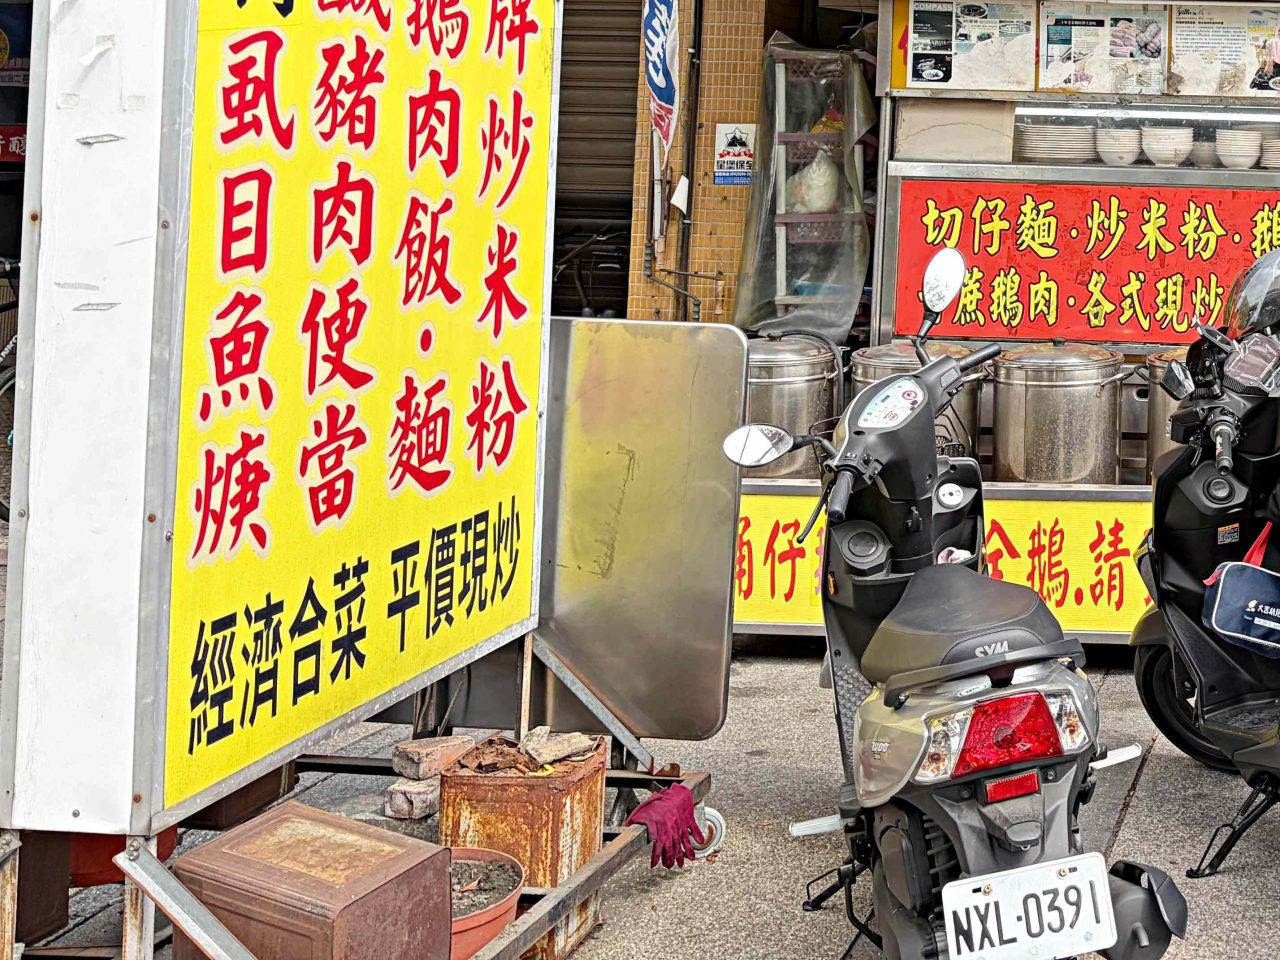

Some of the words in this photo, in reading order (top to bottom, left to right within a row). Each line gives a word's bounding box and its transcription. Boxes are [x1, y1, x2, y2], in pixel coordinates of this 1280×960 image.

[914, 3, 952, 11] COMPASS
[188, 557, 370, 756] 經濟合菜
[387, 496, 521, 653] 平價現炒
